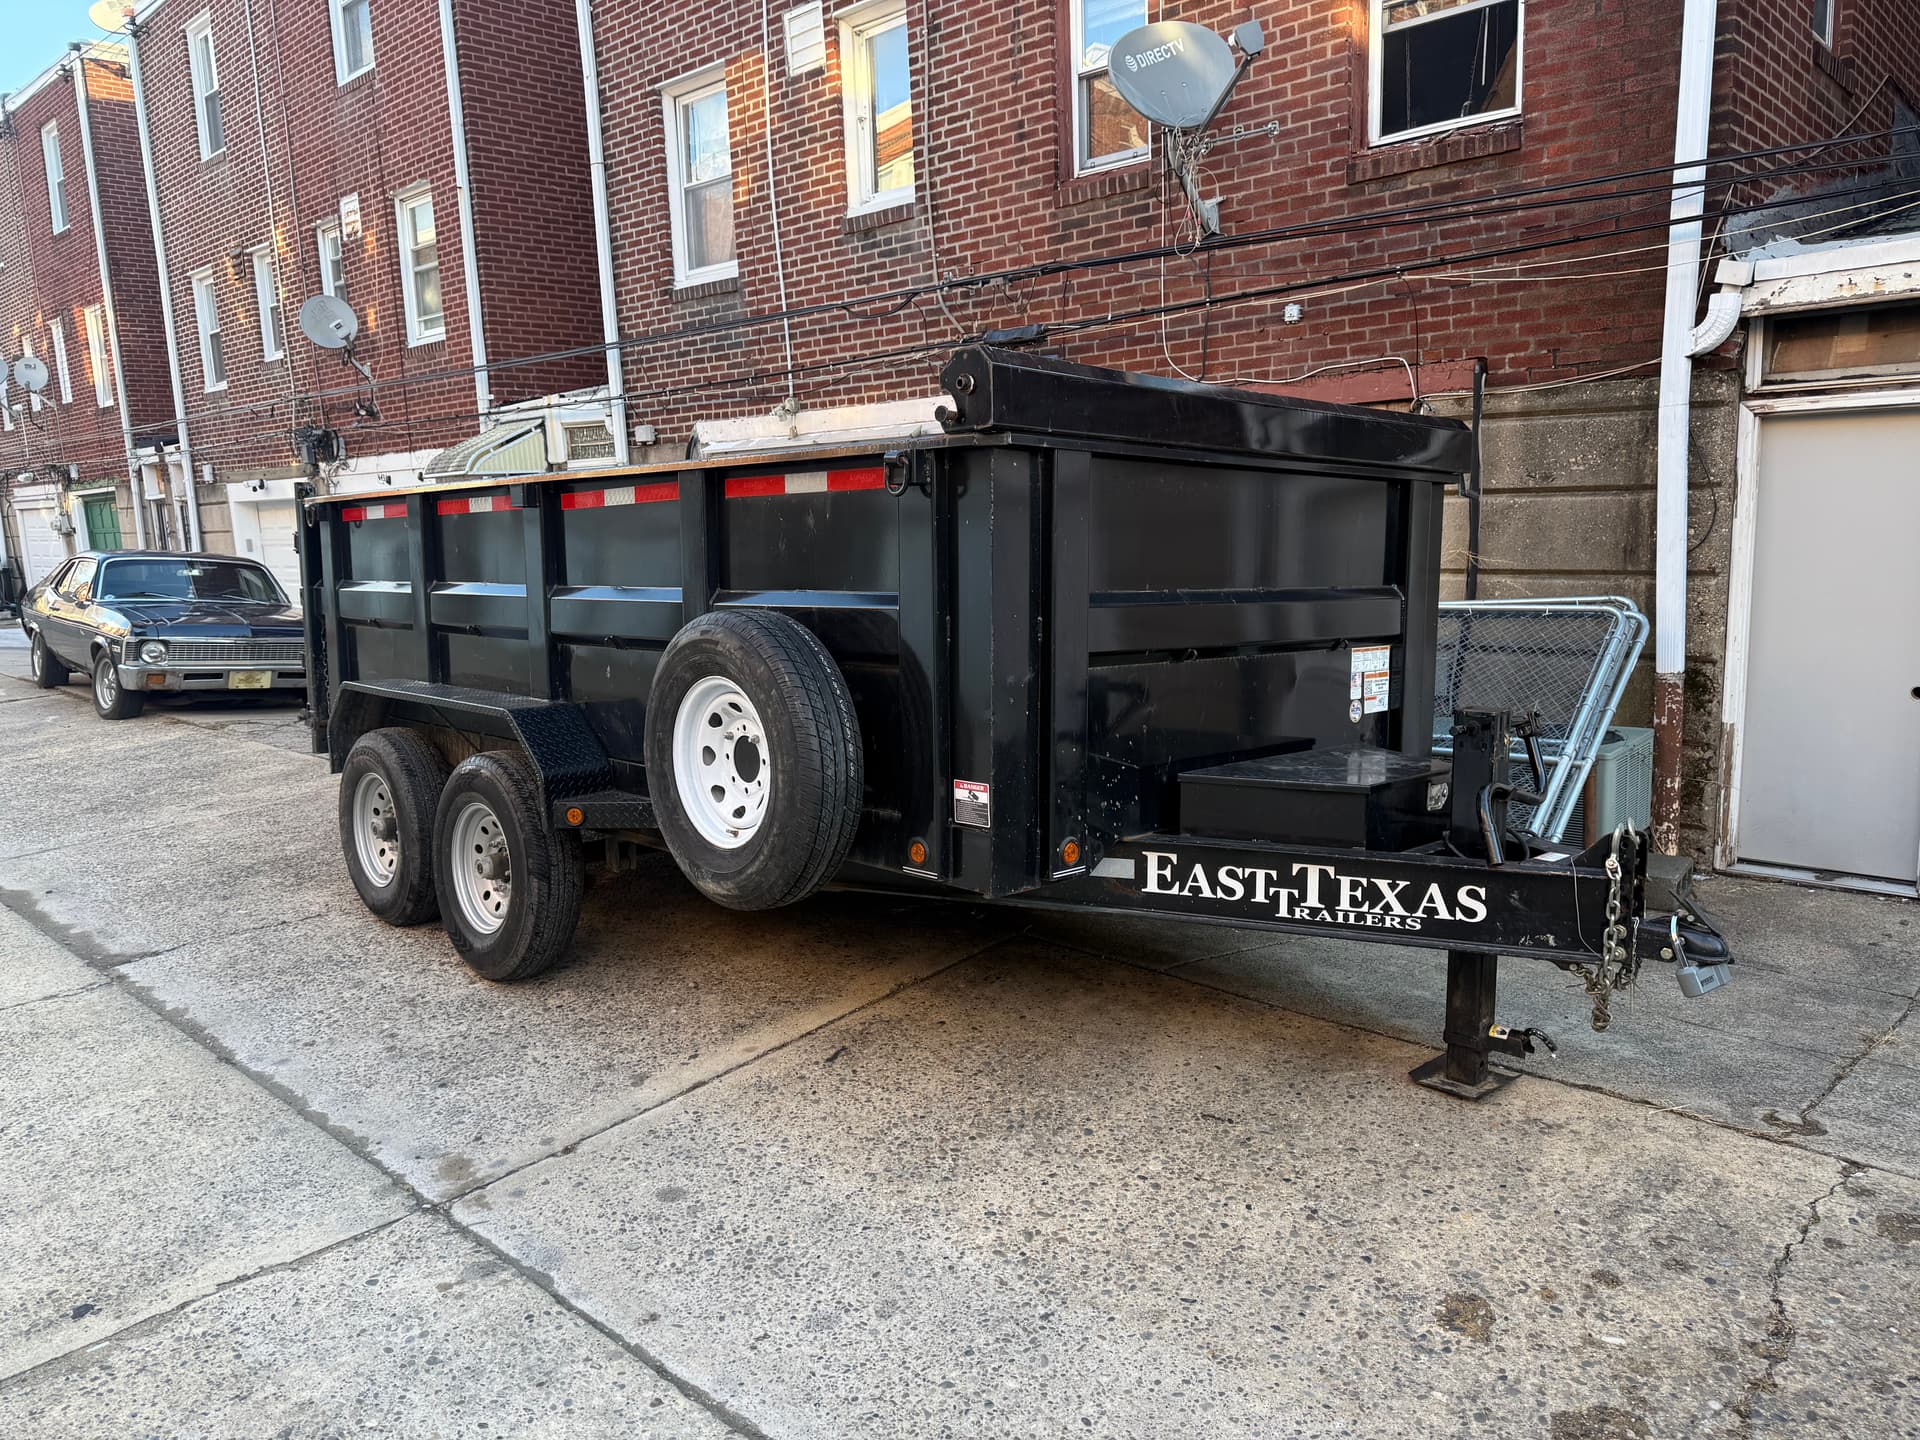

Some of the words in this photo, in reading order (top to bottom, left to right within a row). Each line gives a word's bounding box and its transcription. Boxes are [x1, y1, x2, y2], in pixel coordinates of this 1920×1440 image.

[1136, 38, 1185, 68] DIRECTV
[1141, 851, 1278, 903] EAST
[1292, 863, 1488, 923] TEXAS
[1269, 887, 1422, 931] TRAILERS
